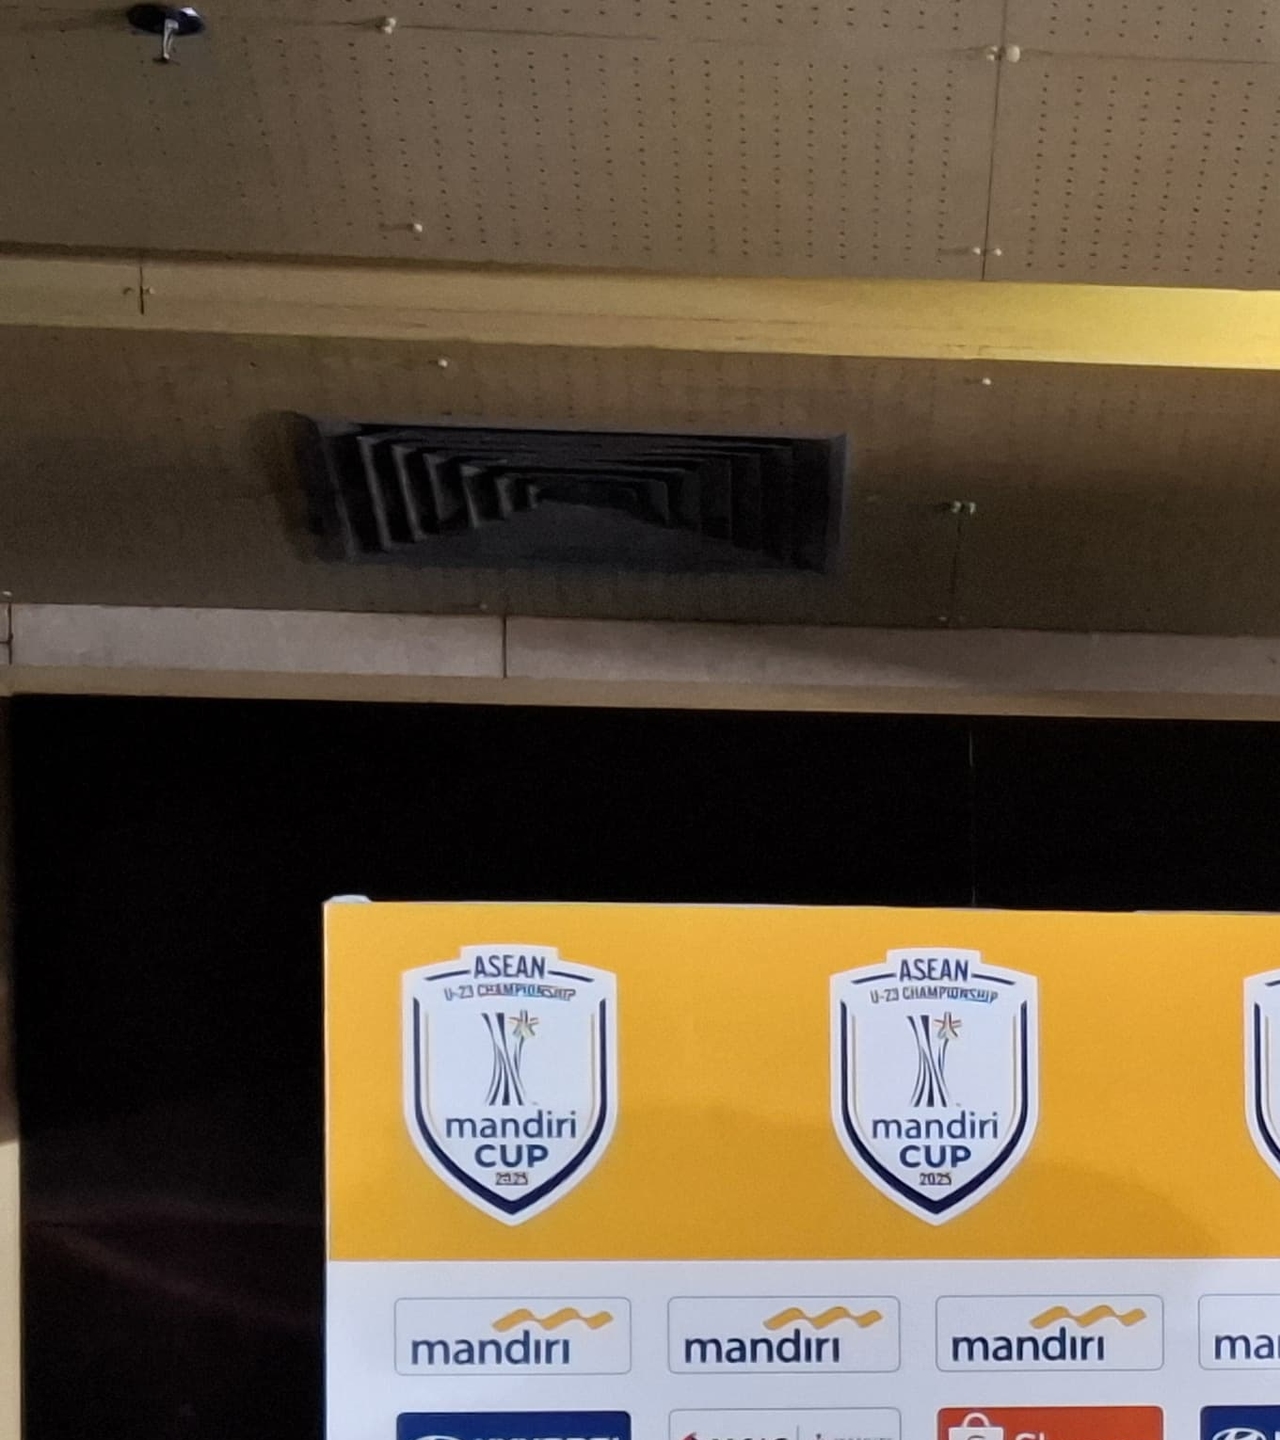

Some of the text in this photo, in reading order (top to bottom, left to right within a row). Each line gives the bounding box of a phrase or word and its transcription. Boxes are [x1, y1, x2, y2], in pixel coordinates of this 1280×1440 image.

[474, 955, 545, 978] ASEAN
[900, 959, 968, 981] ASEAN
[446, 1110, 576, 1138] mandiri
[873, 1112, 997, 1139] mandiri
[475, 1144, 548, 1167] CUP
[900, 1145, 971, 1168] CUP
[412, 1330, 569, 1365] mandiri
[685, 1329, 839, 1363] mandiri
[953, 1327, 1104, 1361] mandiri
